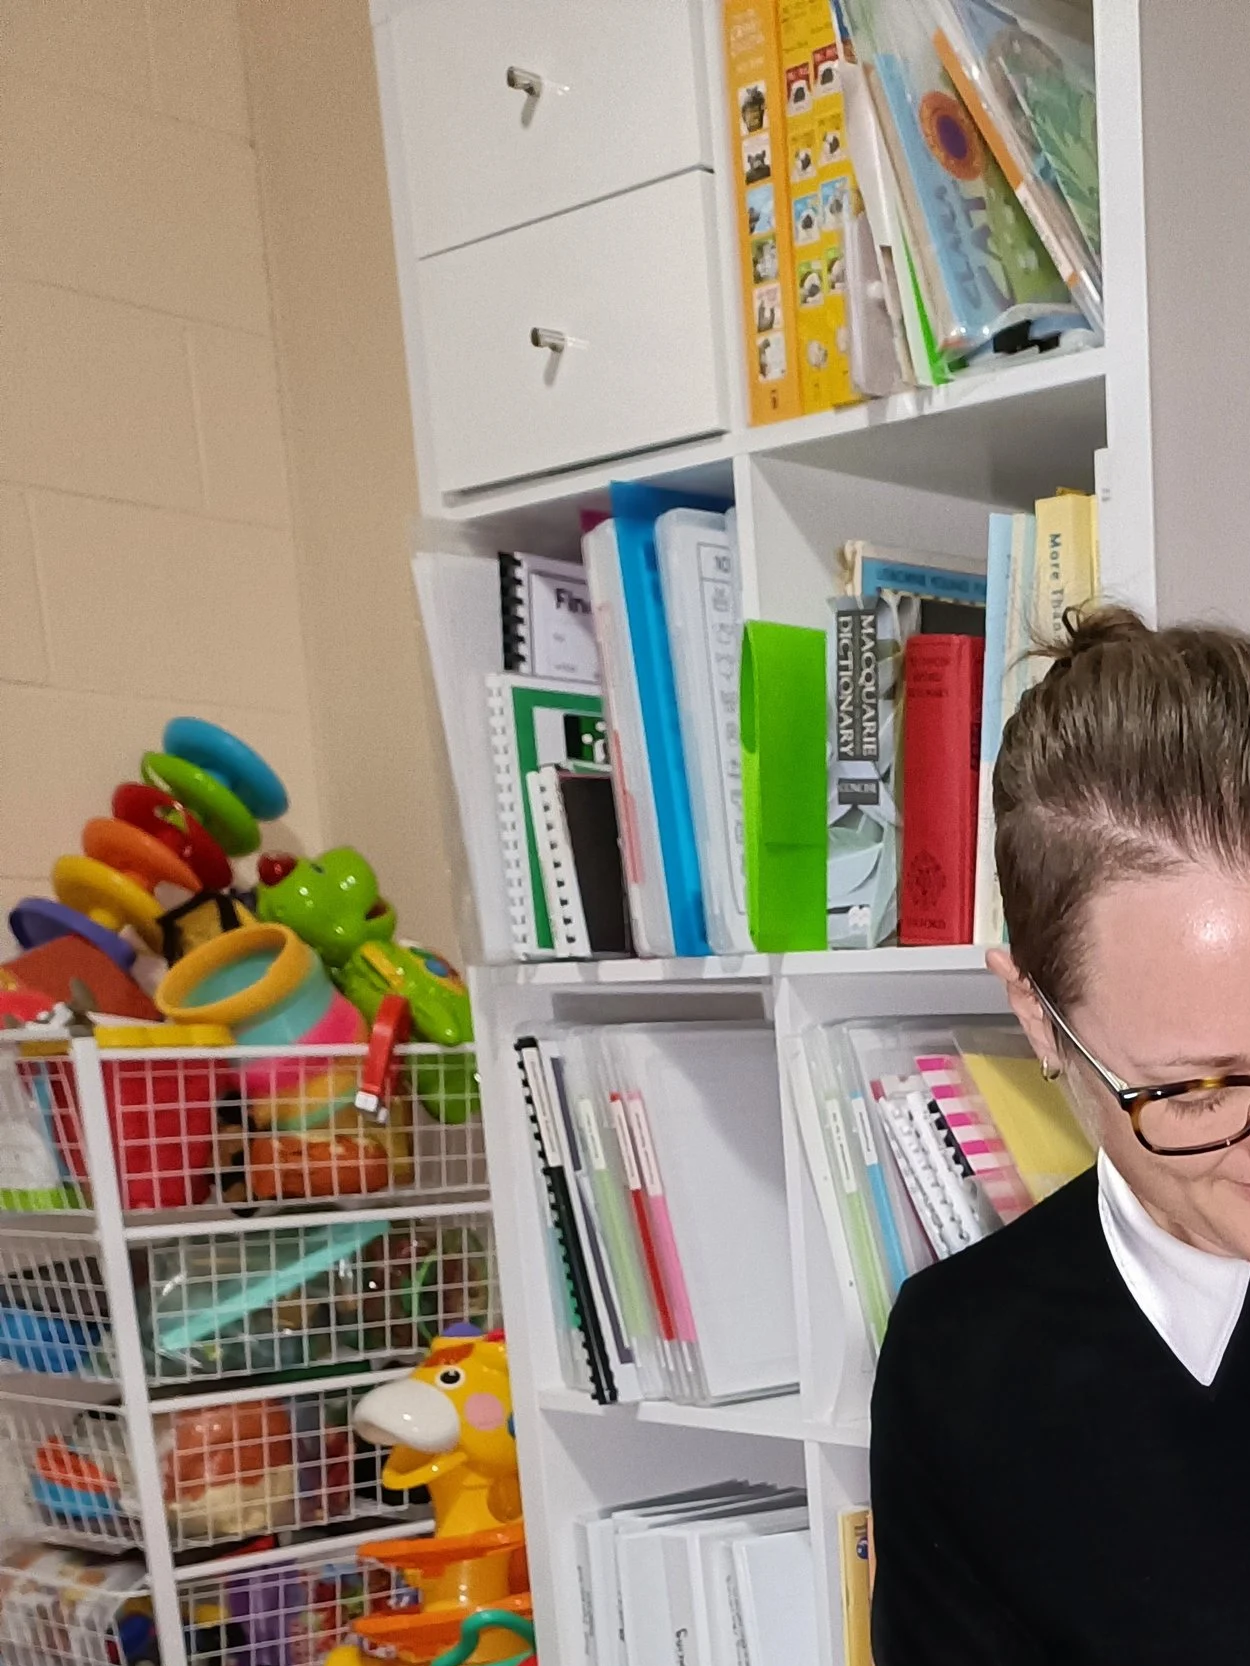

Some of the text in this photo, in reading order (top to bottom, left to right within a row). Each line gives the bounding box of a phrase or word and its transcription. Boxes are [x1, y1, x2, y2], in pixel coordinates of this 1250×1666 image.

[1049, 533, 1062, 580] More
[837, 615, 855, 757] DICTIONARY
[859, 615, 877, 757] MACQUARIE
